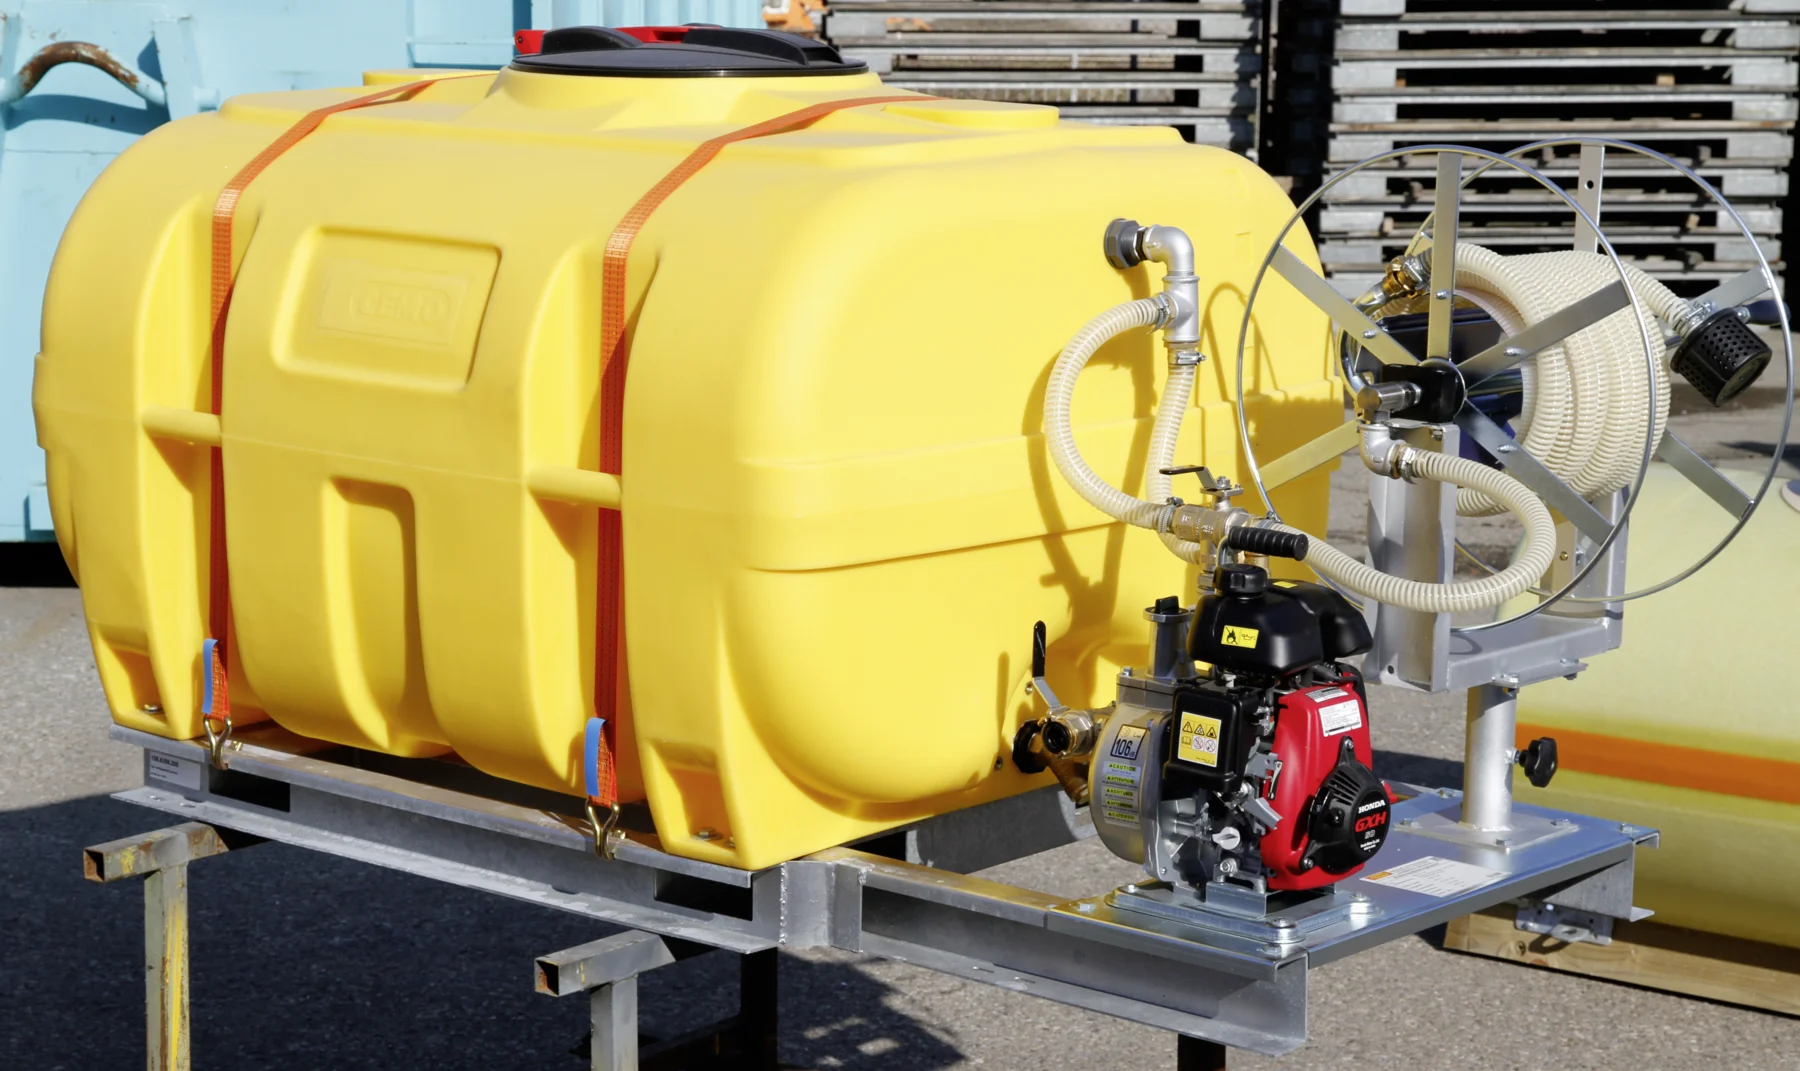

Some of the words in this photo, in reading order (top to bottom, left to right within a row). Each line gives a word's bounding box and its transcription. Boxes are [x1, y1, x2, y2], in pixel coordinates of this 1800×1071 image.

[1115, 738, 1133, 757] 106
[1112, 763, 1136, 772] CAUTION
[1358, 799, 1386, 814] HONDA
[1355, 811, 1387, 833] GXH
